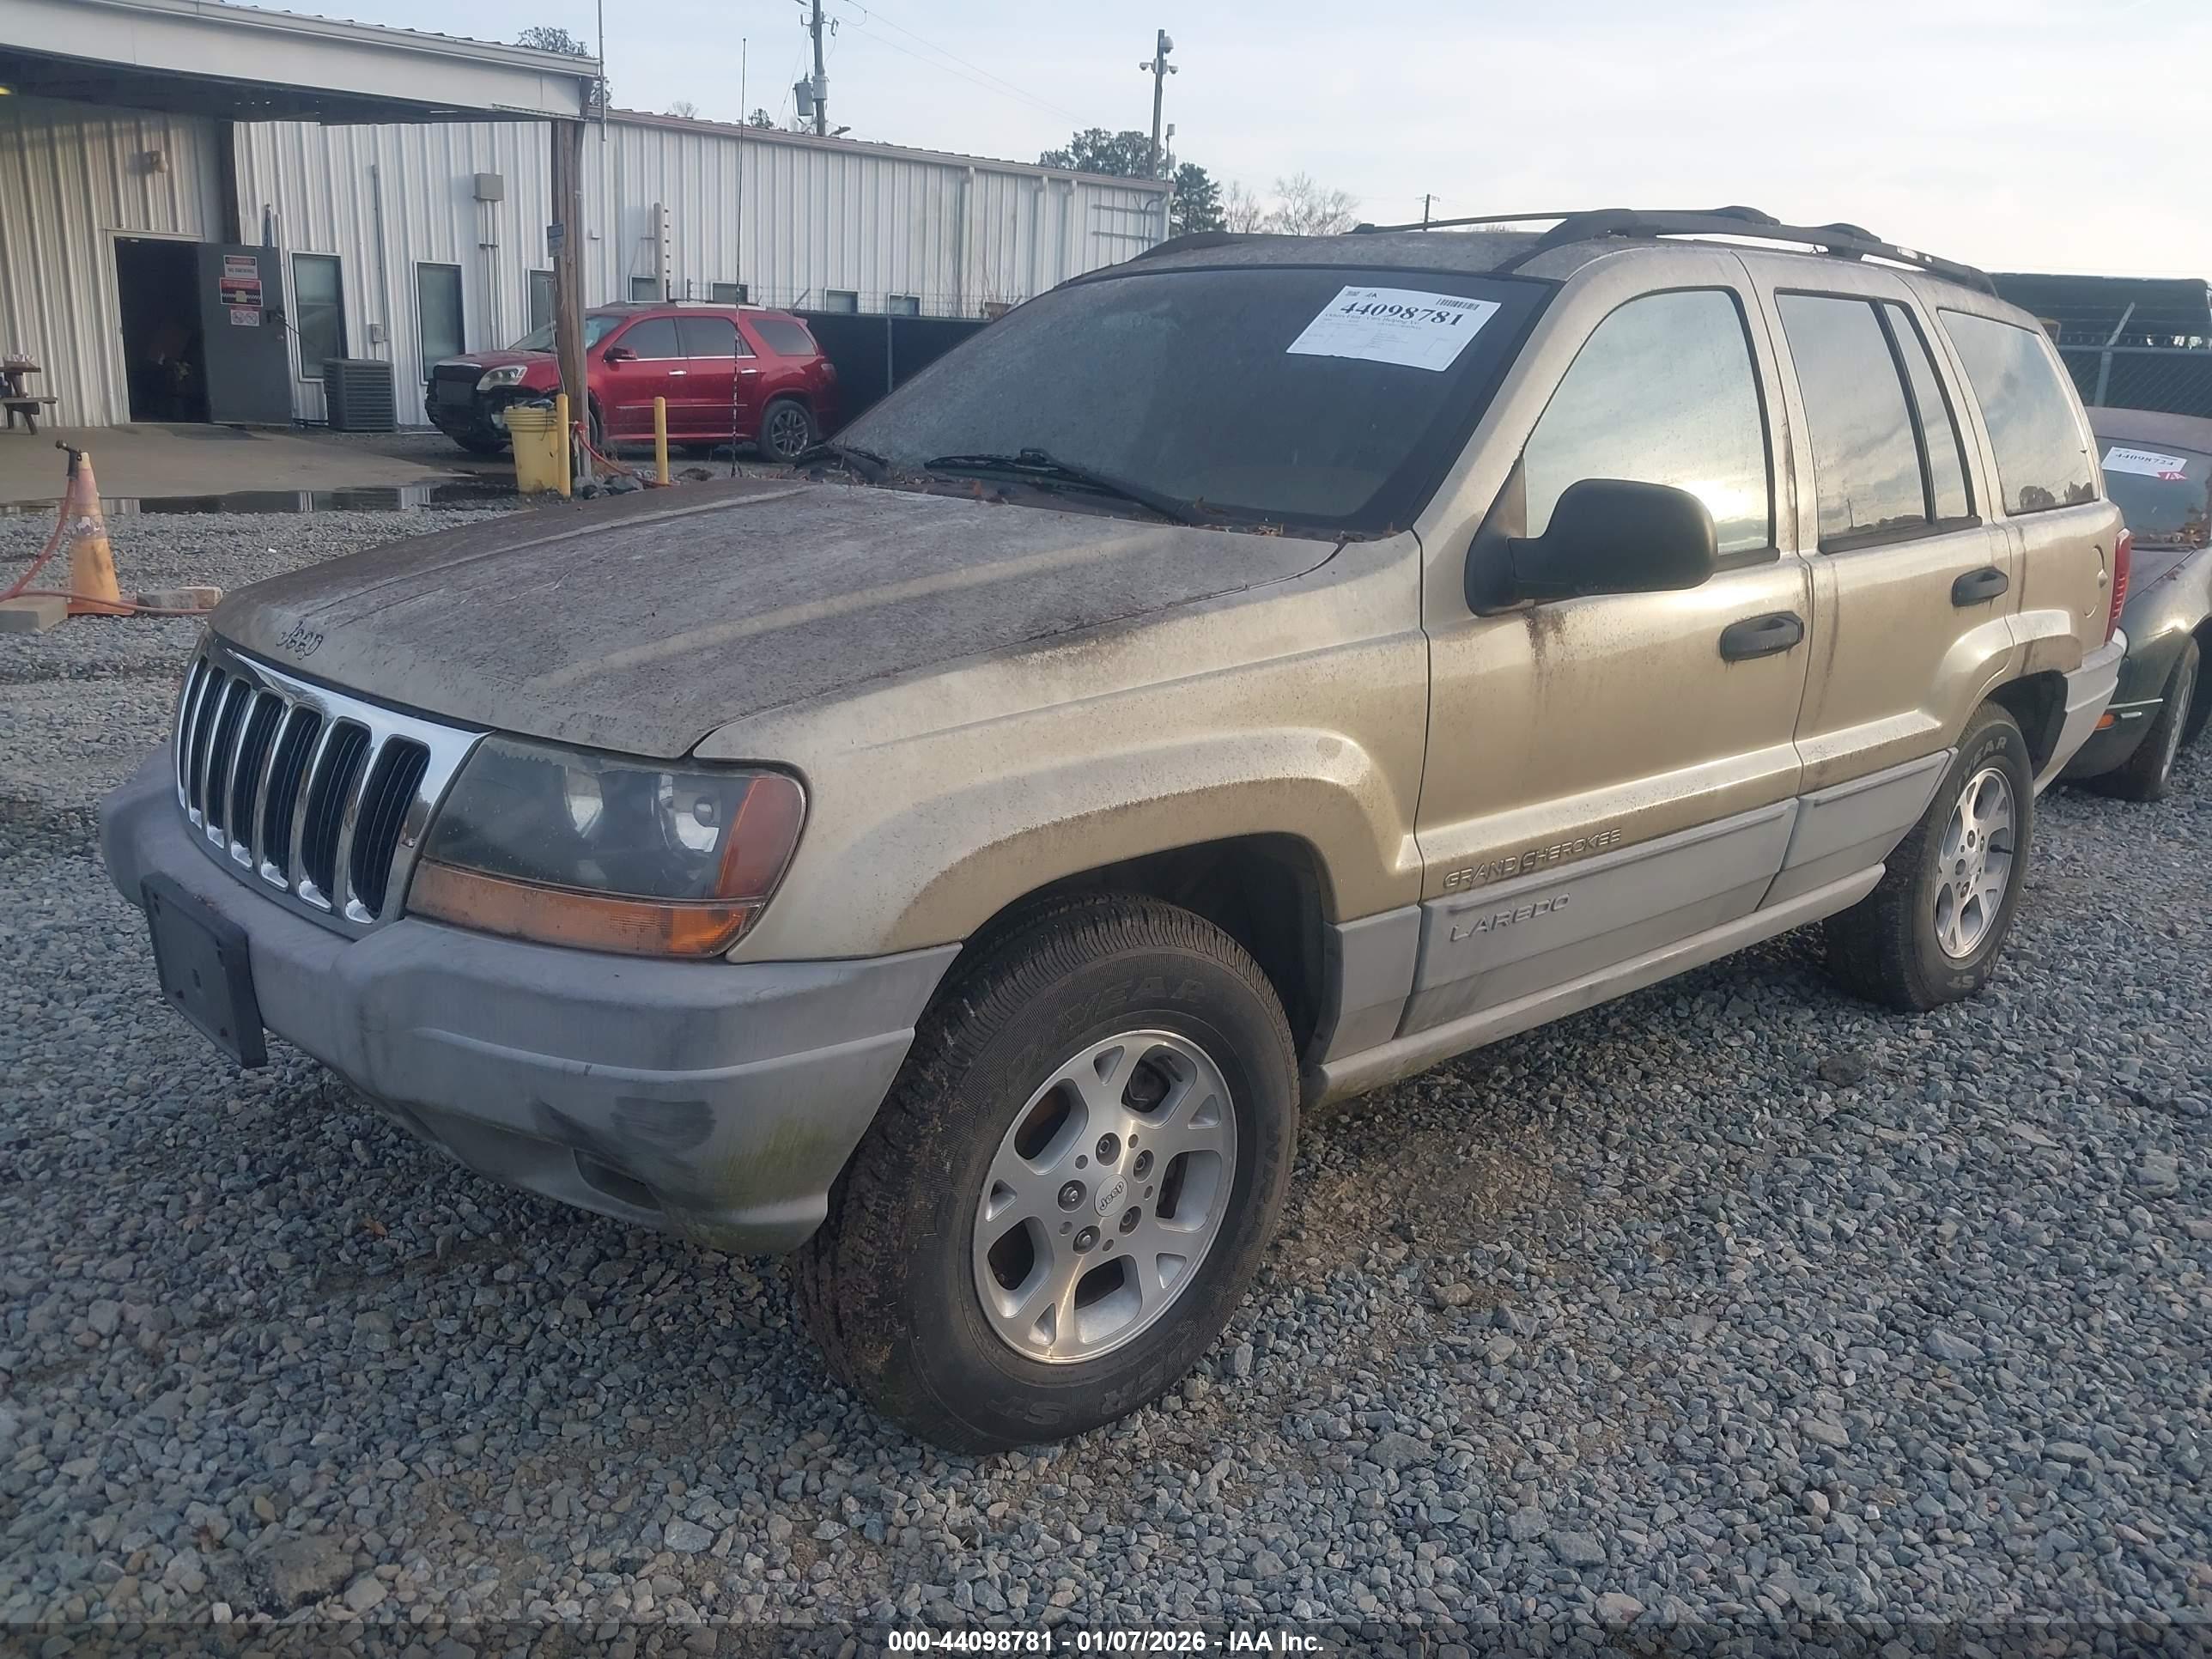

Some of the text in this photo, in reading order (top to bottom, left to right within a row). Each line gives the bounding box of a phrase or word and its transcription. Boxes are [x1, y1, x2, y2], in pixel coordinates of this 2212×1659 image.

[1340, 301, 1464, 325] 44098781
[276, 620, 324, 660] Jeep
[1443, 827, 1622, 889] GRAND CHEROKEE
[1449, 893, 1571, 942] LAREDO
[1099, 1181, 1125, 1212] Jeep
